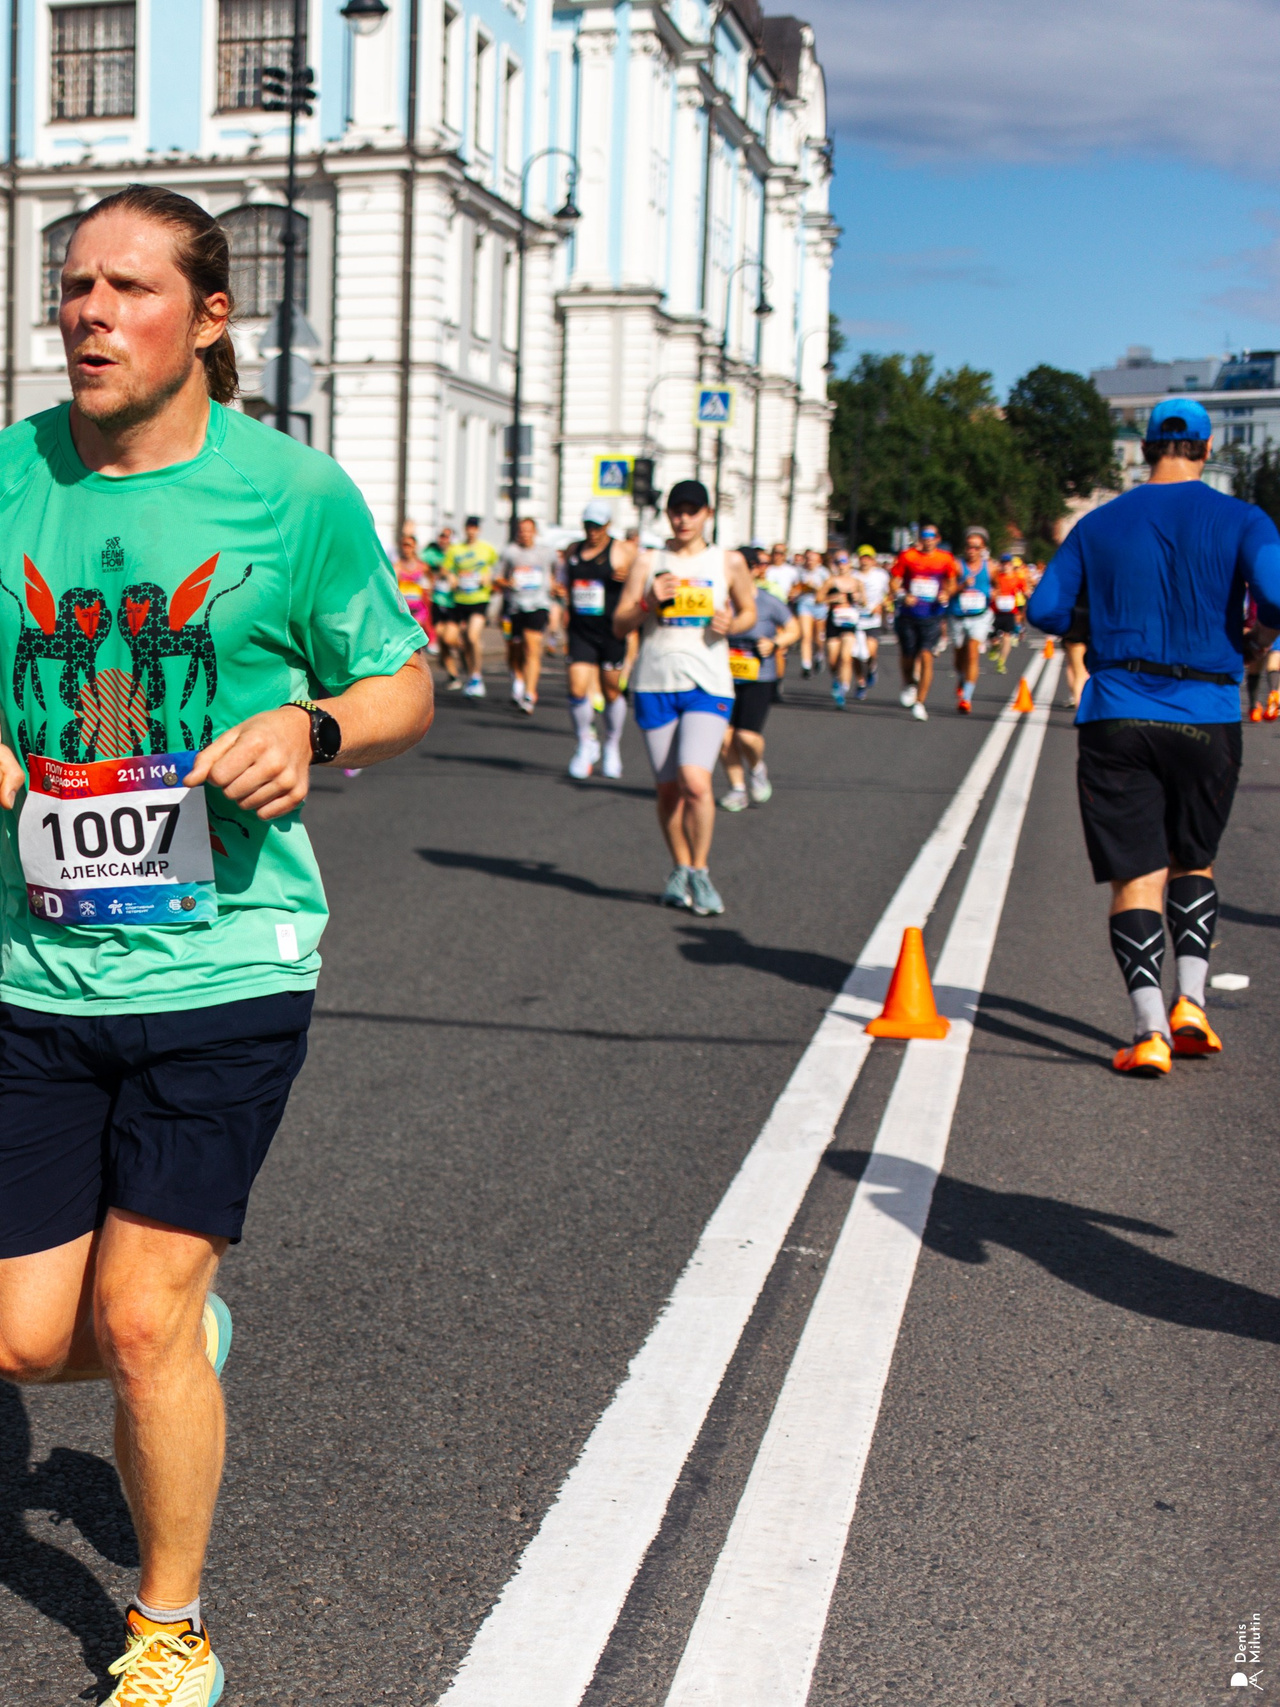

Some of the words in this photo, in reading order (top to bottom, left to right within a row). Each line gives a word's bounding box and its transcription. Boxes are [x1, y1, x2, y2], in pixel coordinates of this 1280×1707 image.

[45, 762, 64, 775] ПОЛУ
[64, 769, 87, 777] 2026
[117, 766, 147, 783] 21,1
[42, 803, 181, 861] 1007
[60, 860, 169, 880] АЛЕКСАНДР
[43, 891, 64, 919] D
